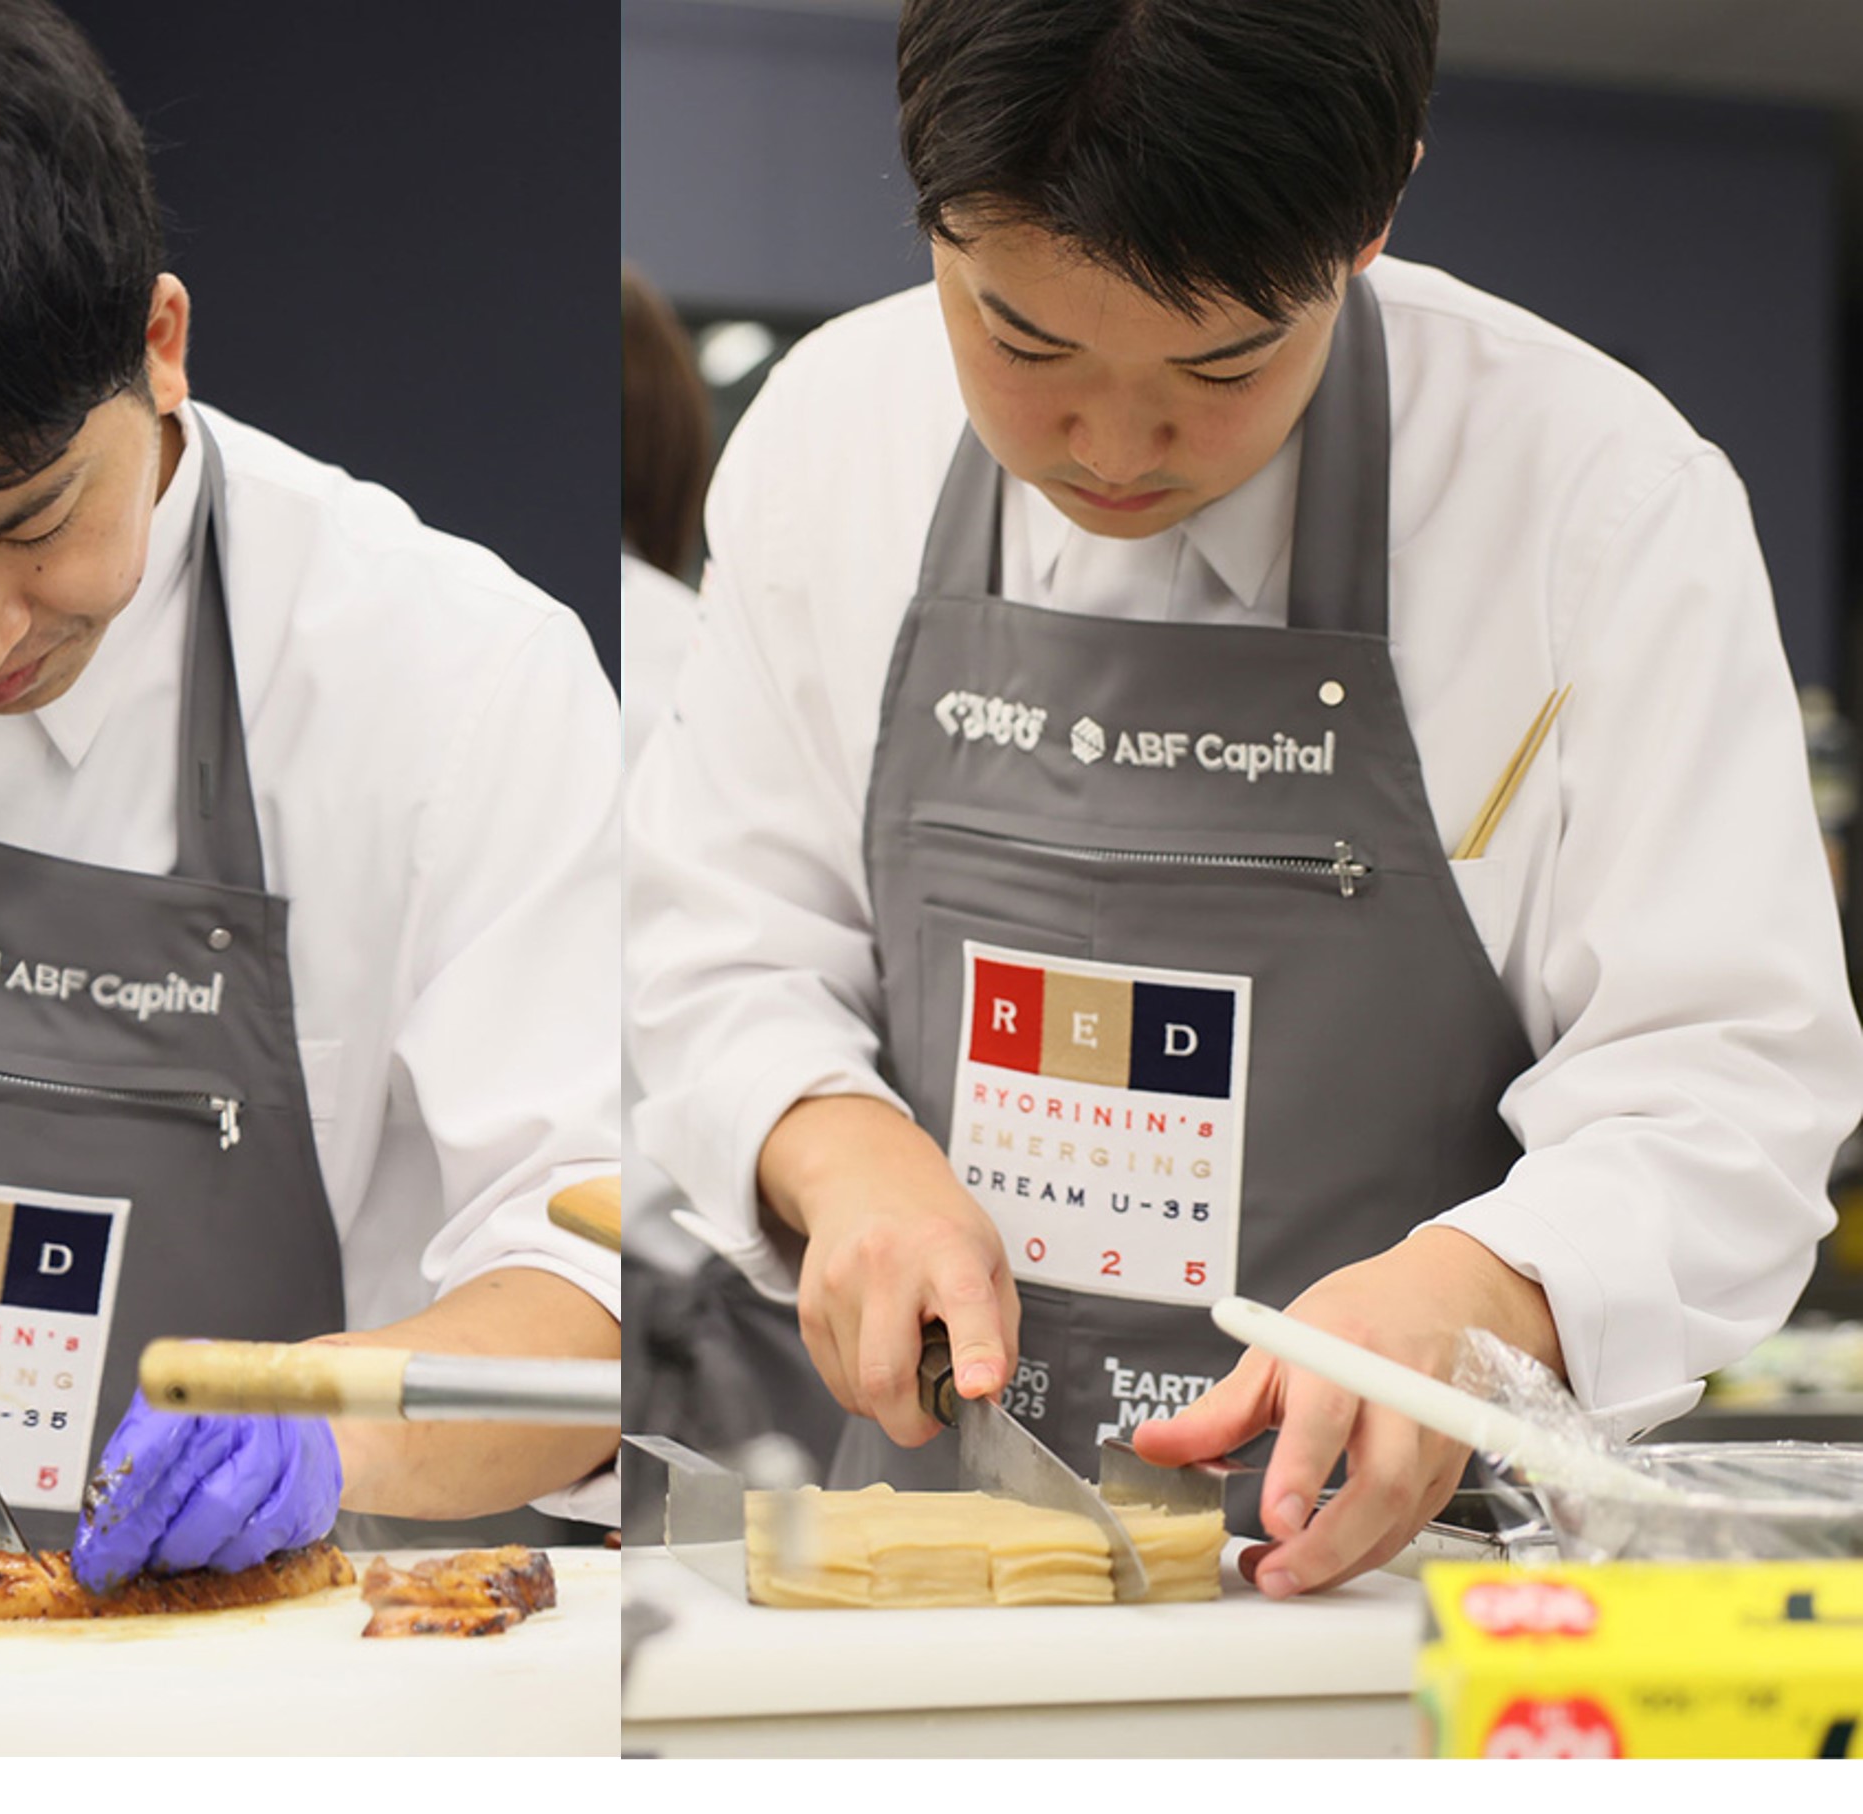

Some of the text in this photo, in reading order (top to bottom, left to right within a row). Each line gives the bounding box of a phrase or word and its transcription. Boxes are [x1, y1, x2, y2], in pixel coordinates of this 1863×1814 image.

[934, 690, 1048, 751] ぐるなび
[1113, 730, 1335, 783] ABF Capital
[5, 960, 225, 1021] ABF Capital
[969, 1122, 1213, 1180] EMERGING
[966, 1165, 1211, 1222] DREAM U-35
[1024, 1236, 1207, 1286] 025
[1001, 1390, 1046, 1420] 025
